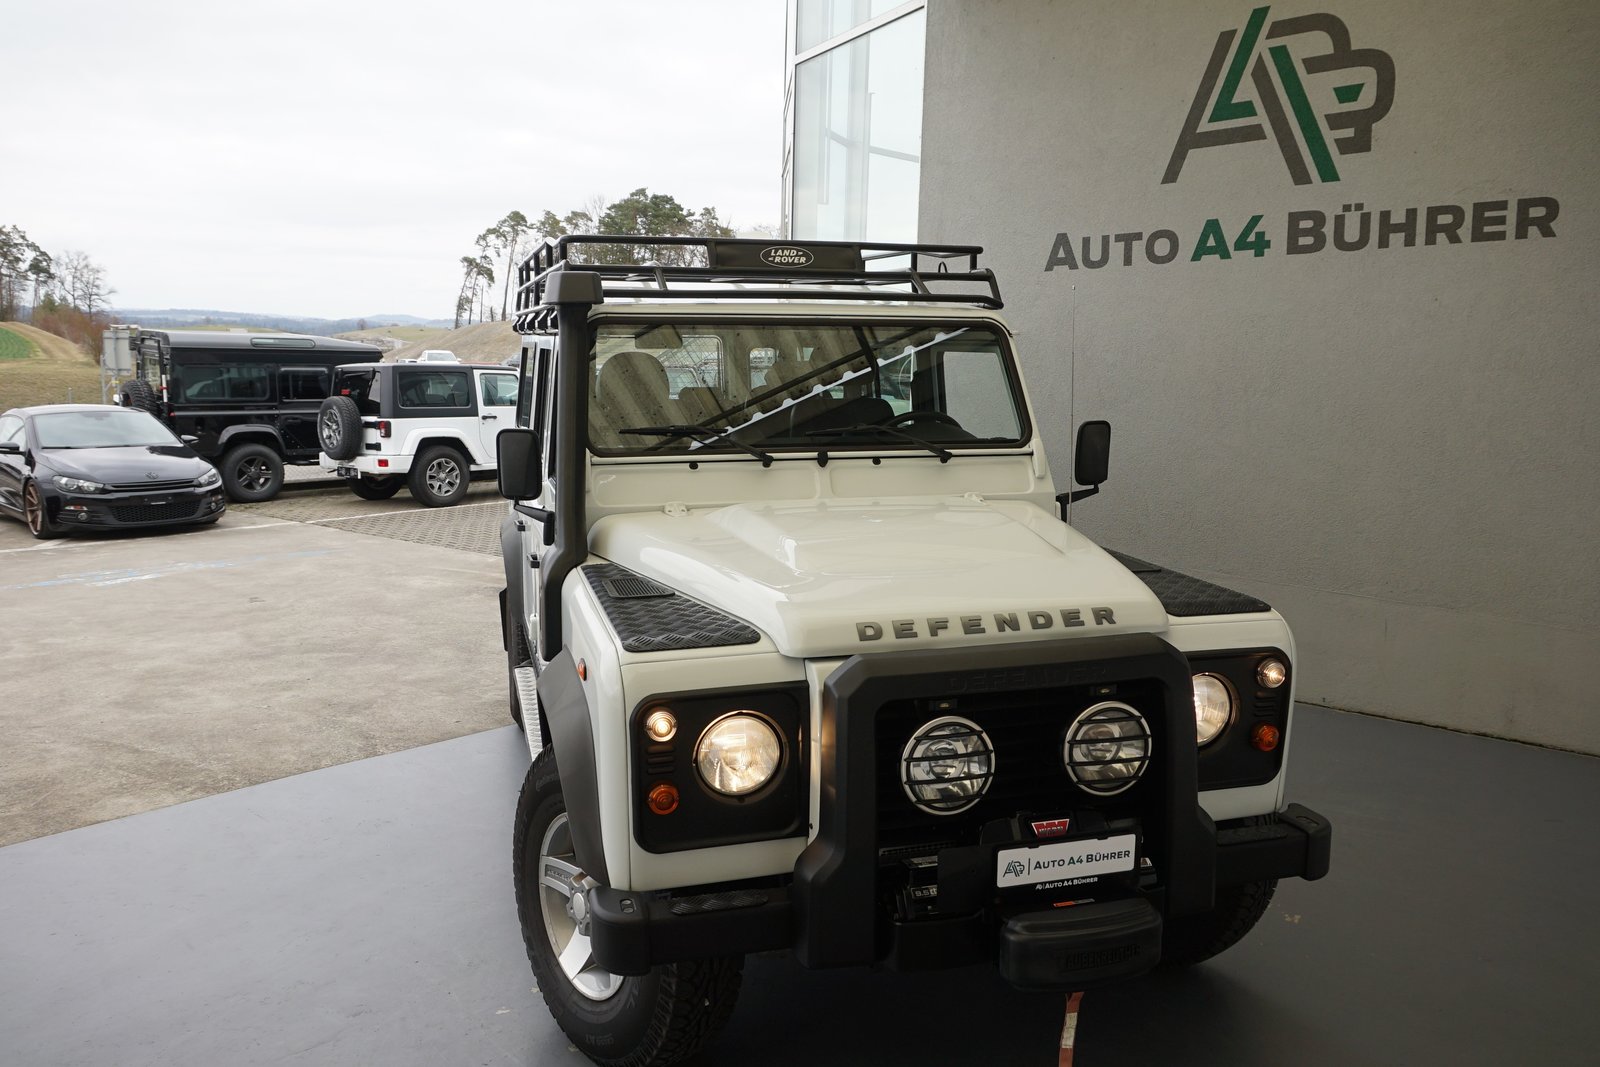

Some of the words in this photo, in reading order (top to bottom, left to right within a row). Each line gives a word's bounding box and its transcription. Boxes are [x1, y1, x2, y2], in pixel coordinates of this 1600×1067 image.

[1043, 229, 1181, 272] AUTO
[1190, 214, 1272, 262] A4
[1285, 196, 1561, 256] BÜHRER
[855, 606, 1118, 641] DEFENDER
[1033, 859, 1066, 870] AUTO
[1067, 855, 1084, 866] A4
[1085, 850, 1131, 863] BÜHRER
[1044, 881, 1063, 889] AUTO
[1063, 879, 1073, 887] A4
[1073, 877, 1098, 885] BÜHRER
